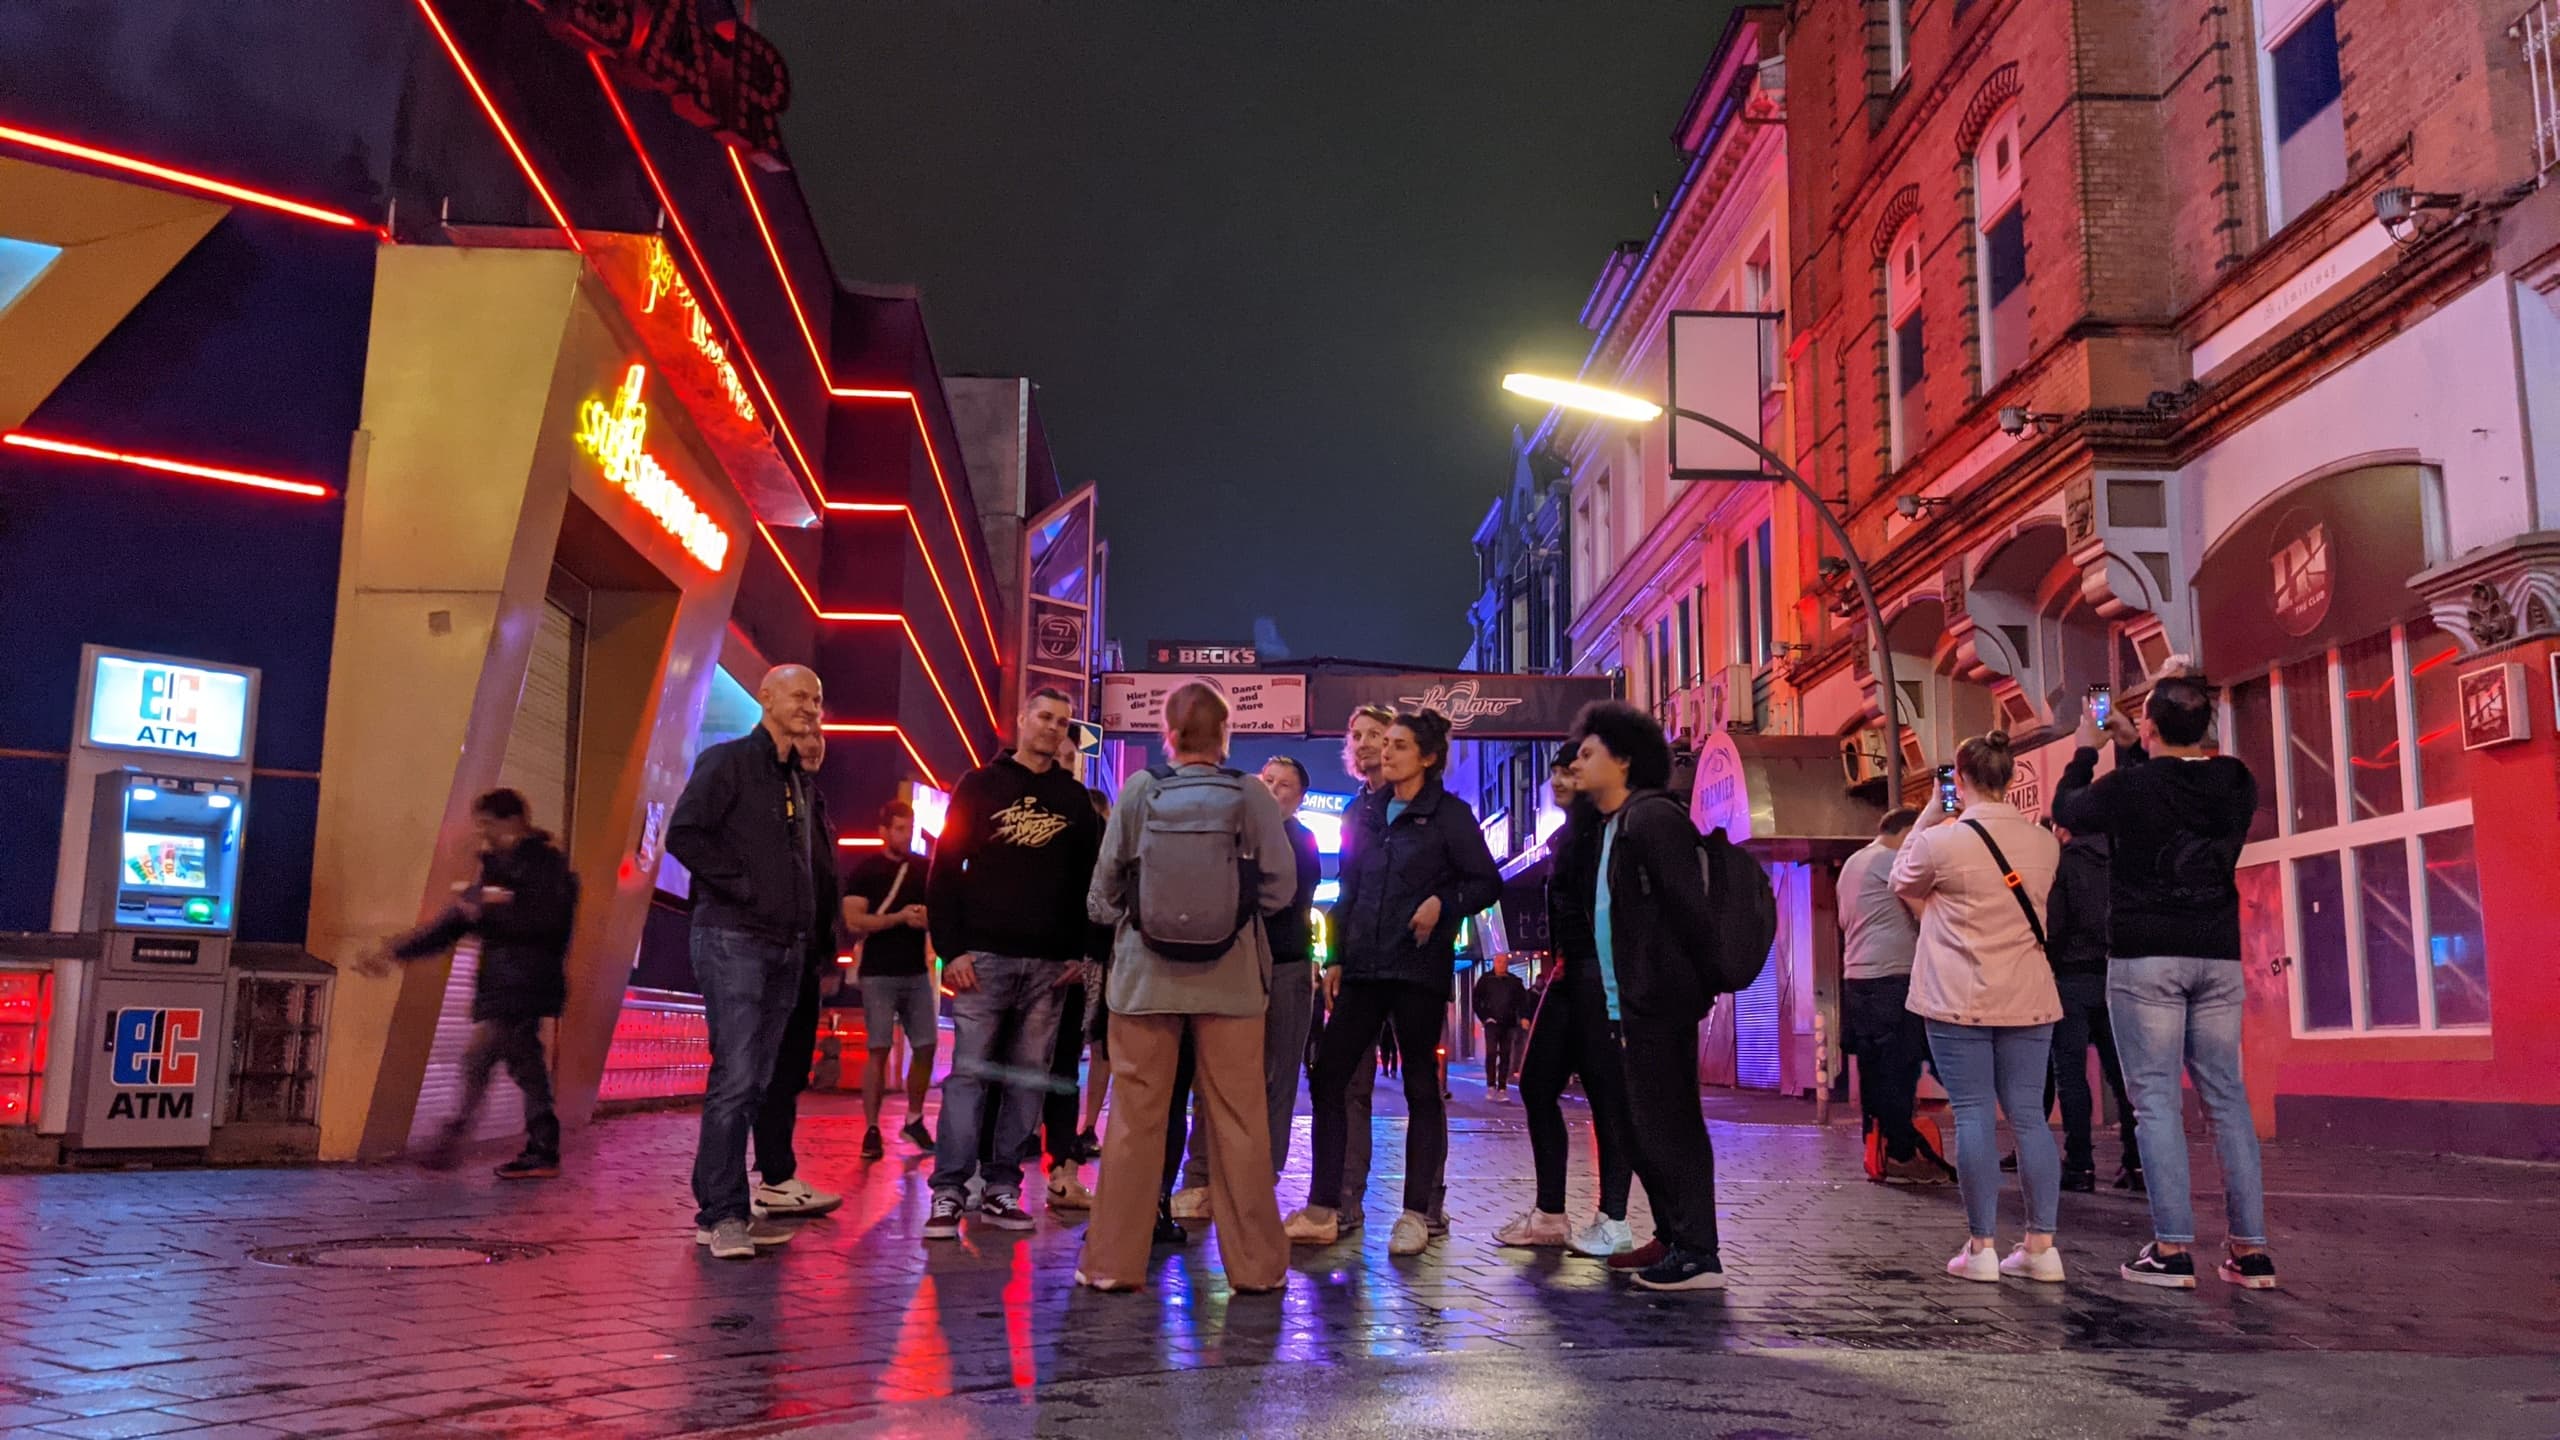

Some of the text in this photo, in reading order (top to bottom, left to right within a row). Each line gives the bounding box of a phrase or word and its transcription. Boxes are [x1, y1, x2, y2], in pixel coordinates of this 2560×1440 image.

[1179, 647, 1256, 664] BECK'S
[1232, 684, 1263, 695] Dance
[1239, 693, 1259, 702] and
[1236, 703, 1264, 712] More
[1448, 680, 1508, 721] plane
[136, 726, 198, 748] ATM
[1302, 793, 1343, 810] DANCE
[107, 1092, 194, 1119] ATM
